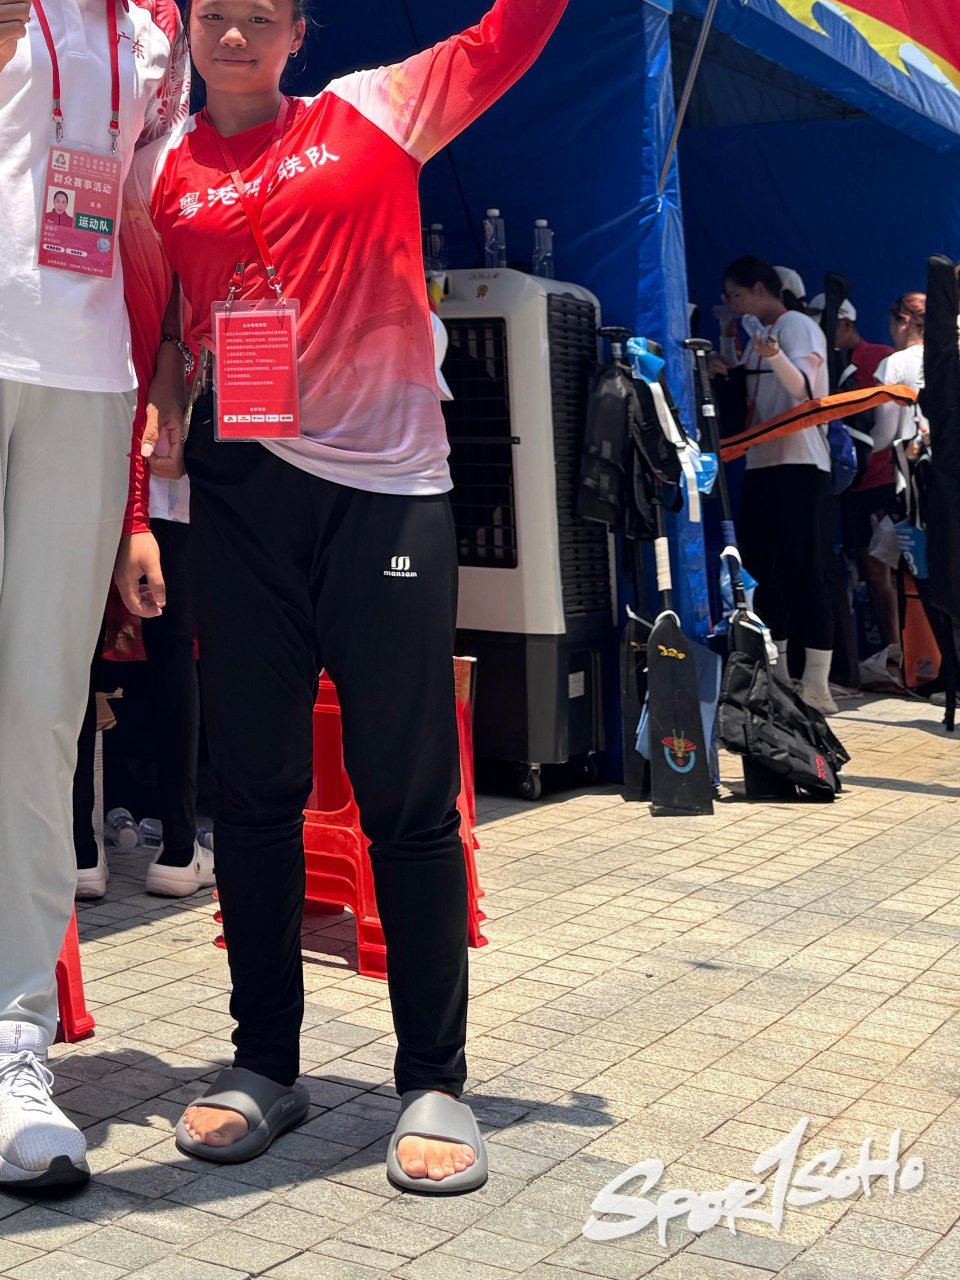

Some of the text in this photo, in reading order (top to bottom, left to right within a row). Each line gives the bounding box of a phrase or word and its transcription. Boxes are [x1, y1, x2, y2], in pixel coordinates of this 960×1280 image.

[53, 173, 112, 195] 群众赛事活动
[79, 216, 109, 232] 运动队
